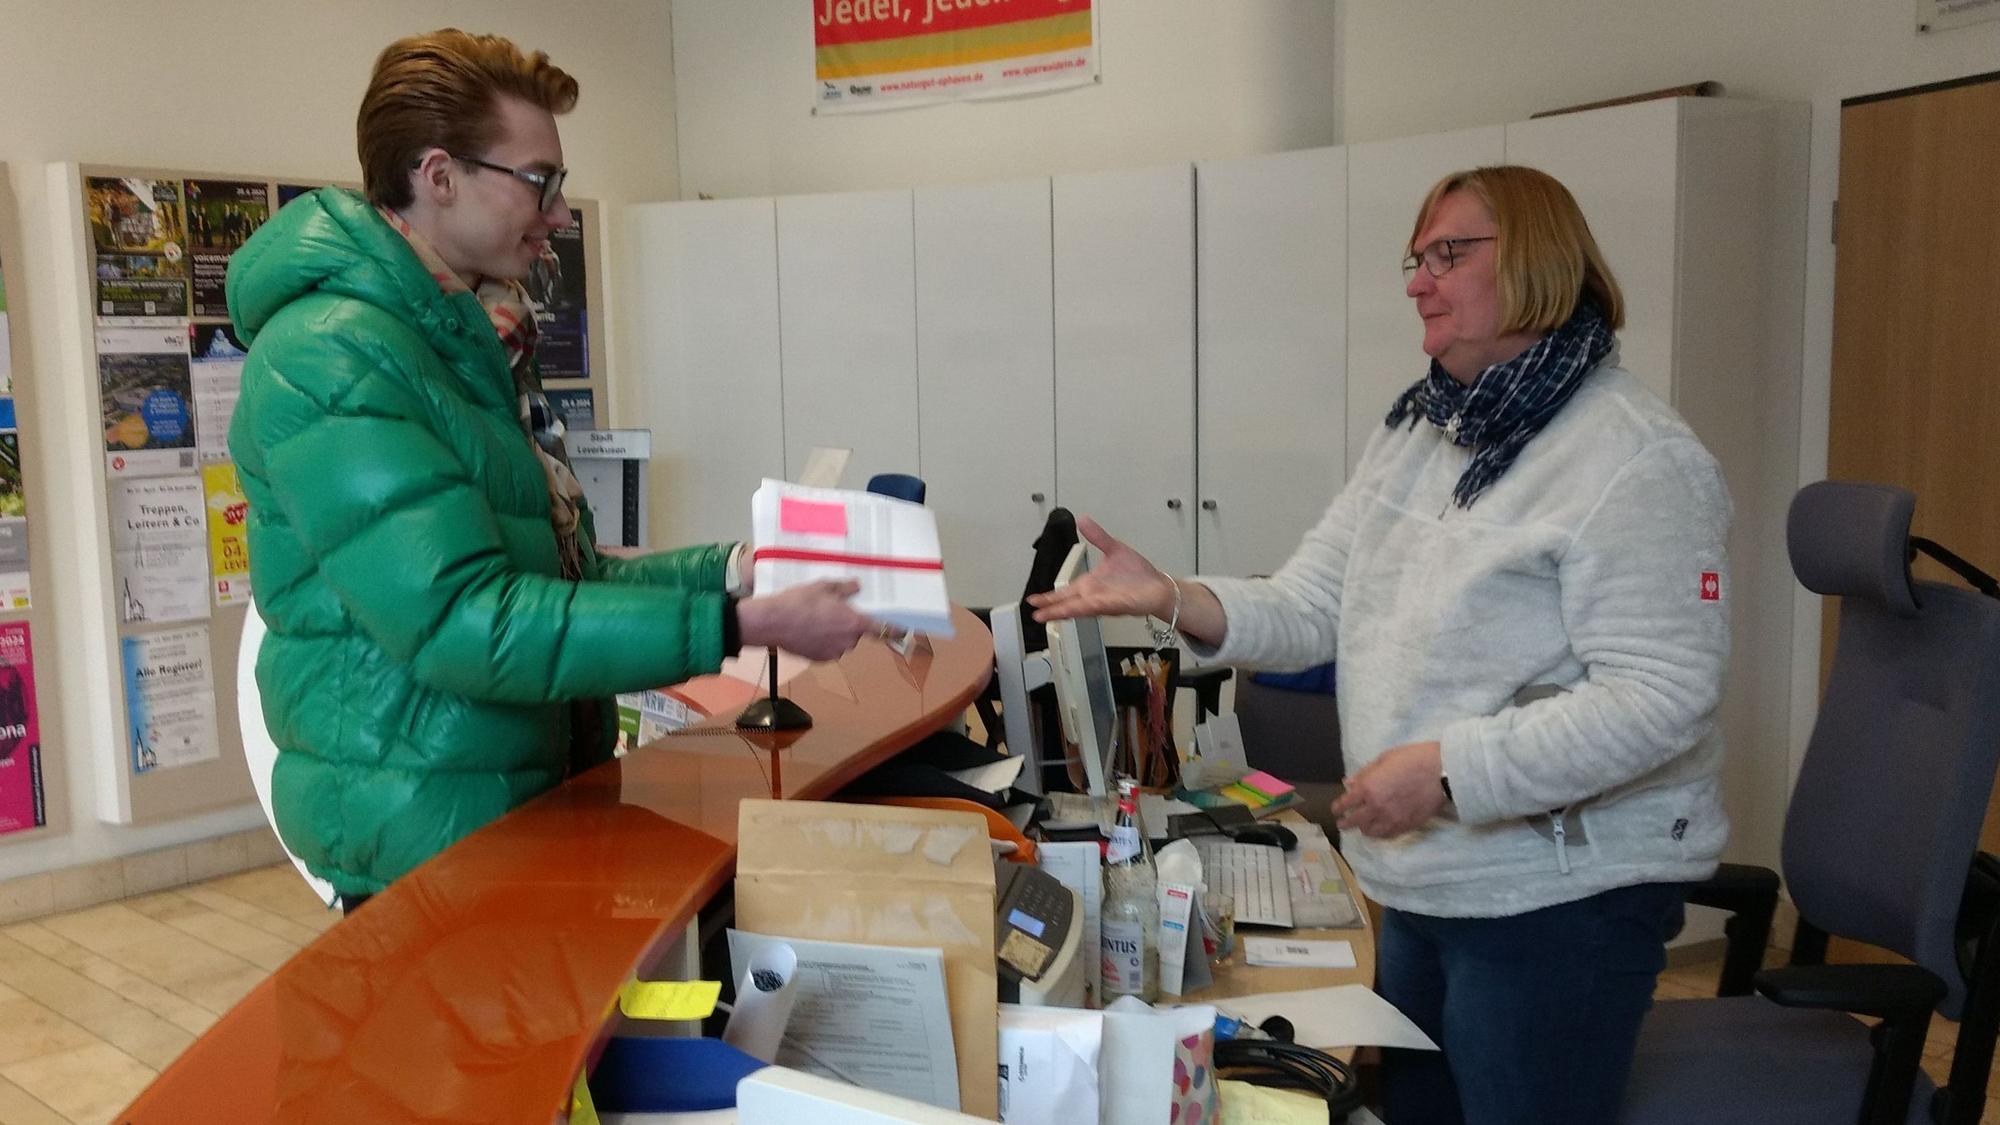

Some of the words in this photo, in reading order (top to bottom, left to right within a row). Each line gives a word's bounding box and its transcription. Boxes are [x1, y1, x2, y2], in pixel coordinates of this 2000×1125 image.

[590, 433, 613, 441] Stadt
[577, 446, 626, 454] Leverkusen
[140, 504, 188, 516] Treppen,
[127, 519, 170, 530] Leitern
[173, 518, 181, 527] &
[184, 516, 200, 527] Co
[136, 667, 157, 679] Alle
[159, 659, 202, 677] Register!
